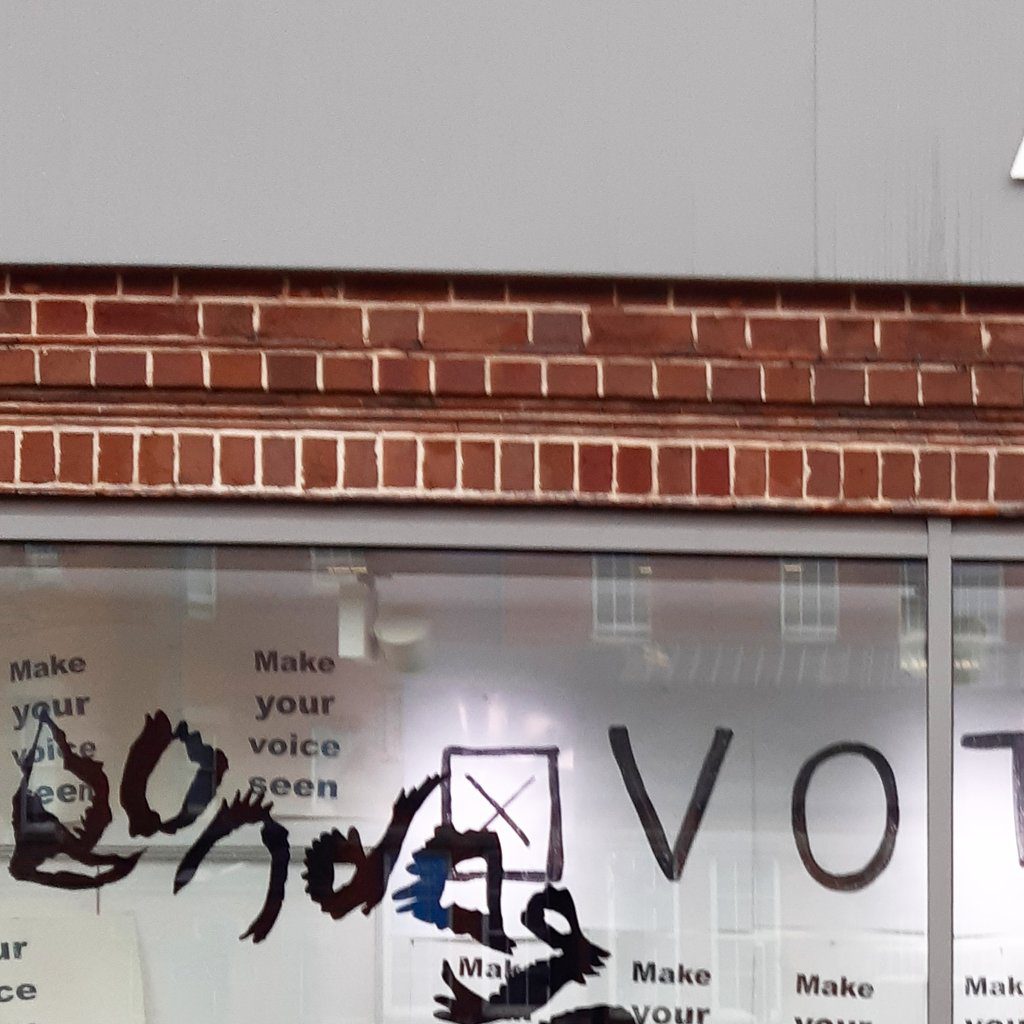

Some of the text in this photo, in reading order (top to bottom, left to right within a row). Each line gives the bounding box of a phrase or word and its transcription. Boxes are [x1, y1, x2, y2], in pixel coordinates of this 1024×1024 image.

[9, 654, 86, 683] Make
[254, 651, 336, 673] Make
[11, 696, 90, 731] your
[255, 694, 336, 721] your
[249, 732, 340, 758] voice
[36, 782, 97, 805] een
[249, 776, 338, 799] seen
[632, 961, 711, 986] Make
[796, 973, 874, 999] Make
